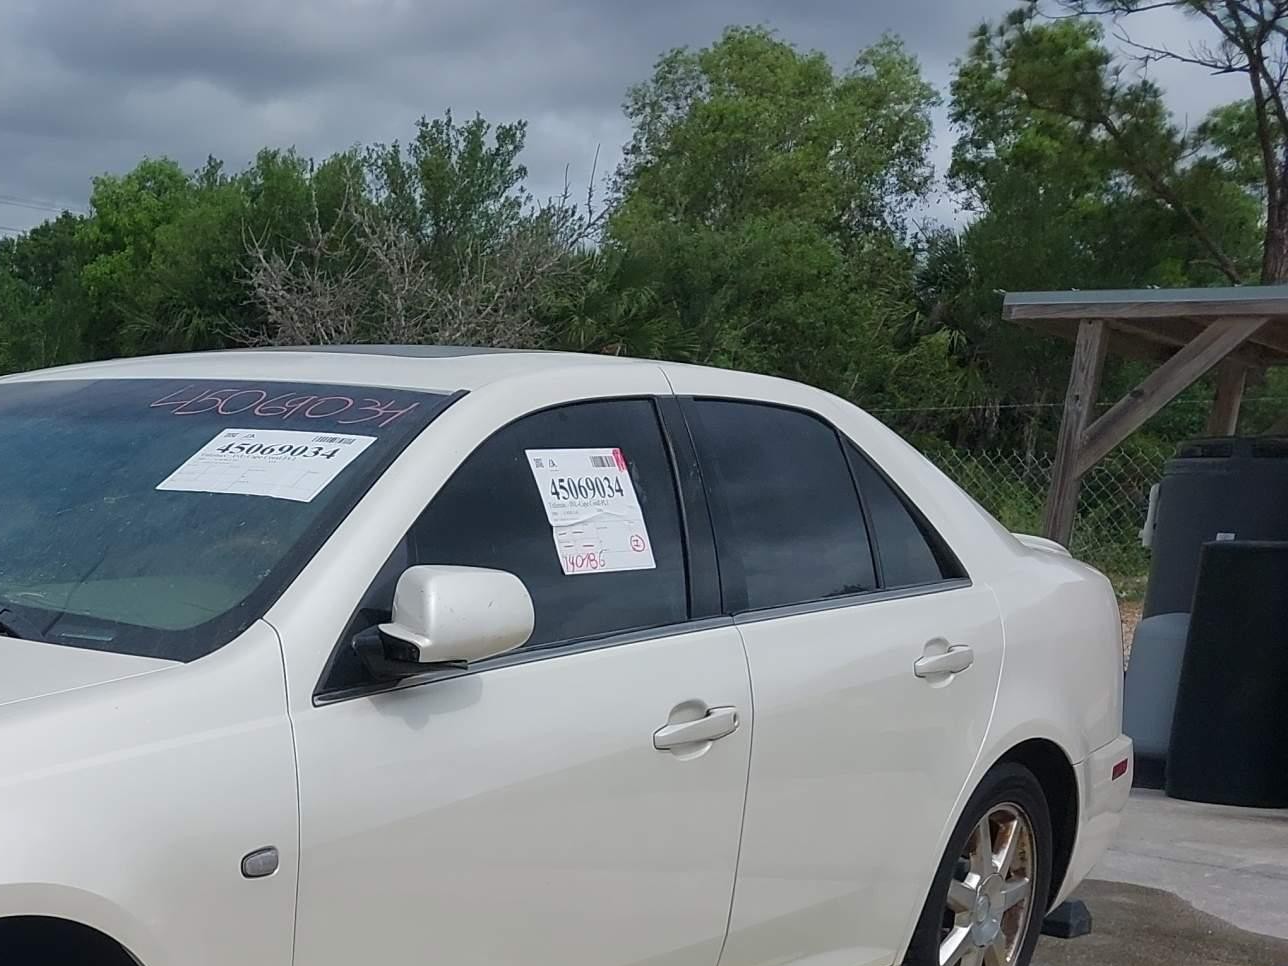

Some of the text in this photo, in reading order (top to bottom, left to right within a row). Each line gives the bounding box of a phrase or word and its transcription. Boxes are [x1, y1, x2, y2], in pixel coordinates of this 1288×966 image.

[149, 384, 421, 428] 45069034
[215, 441, 340, 460] 45069034
[549, 475, 624, 501] 45069034
